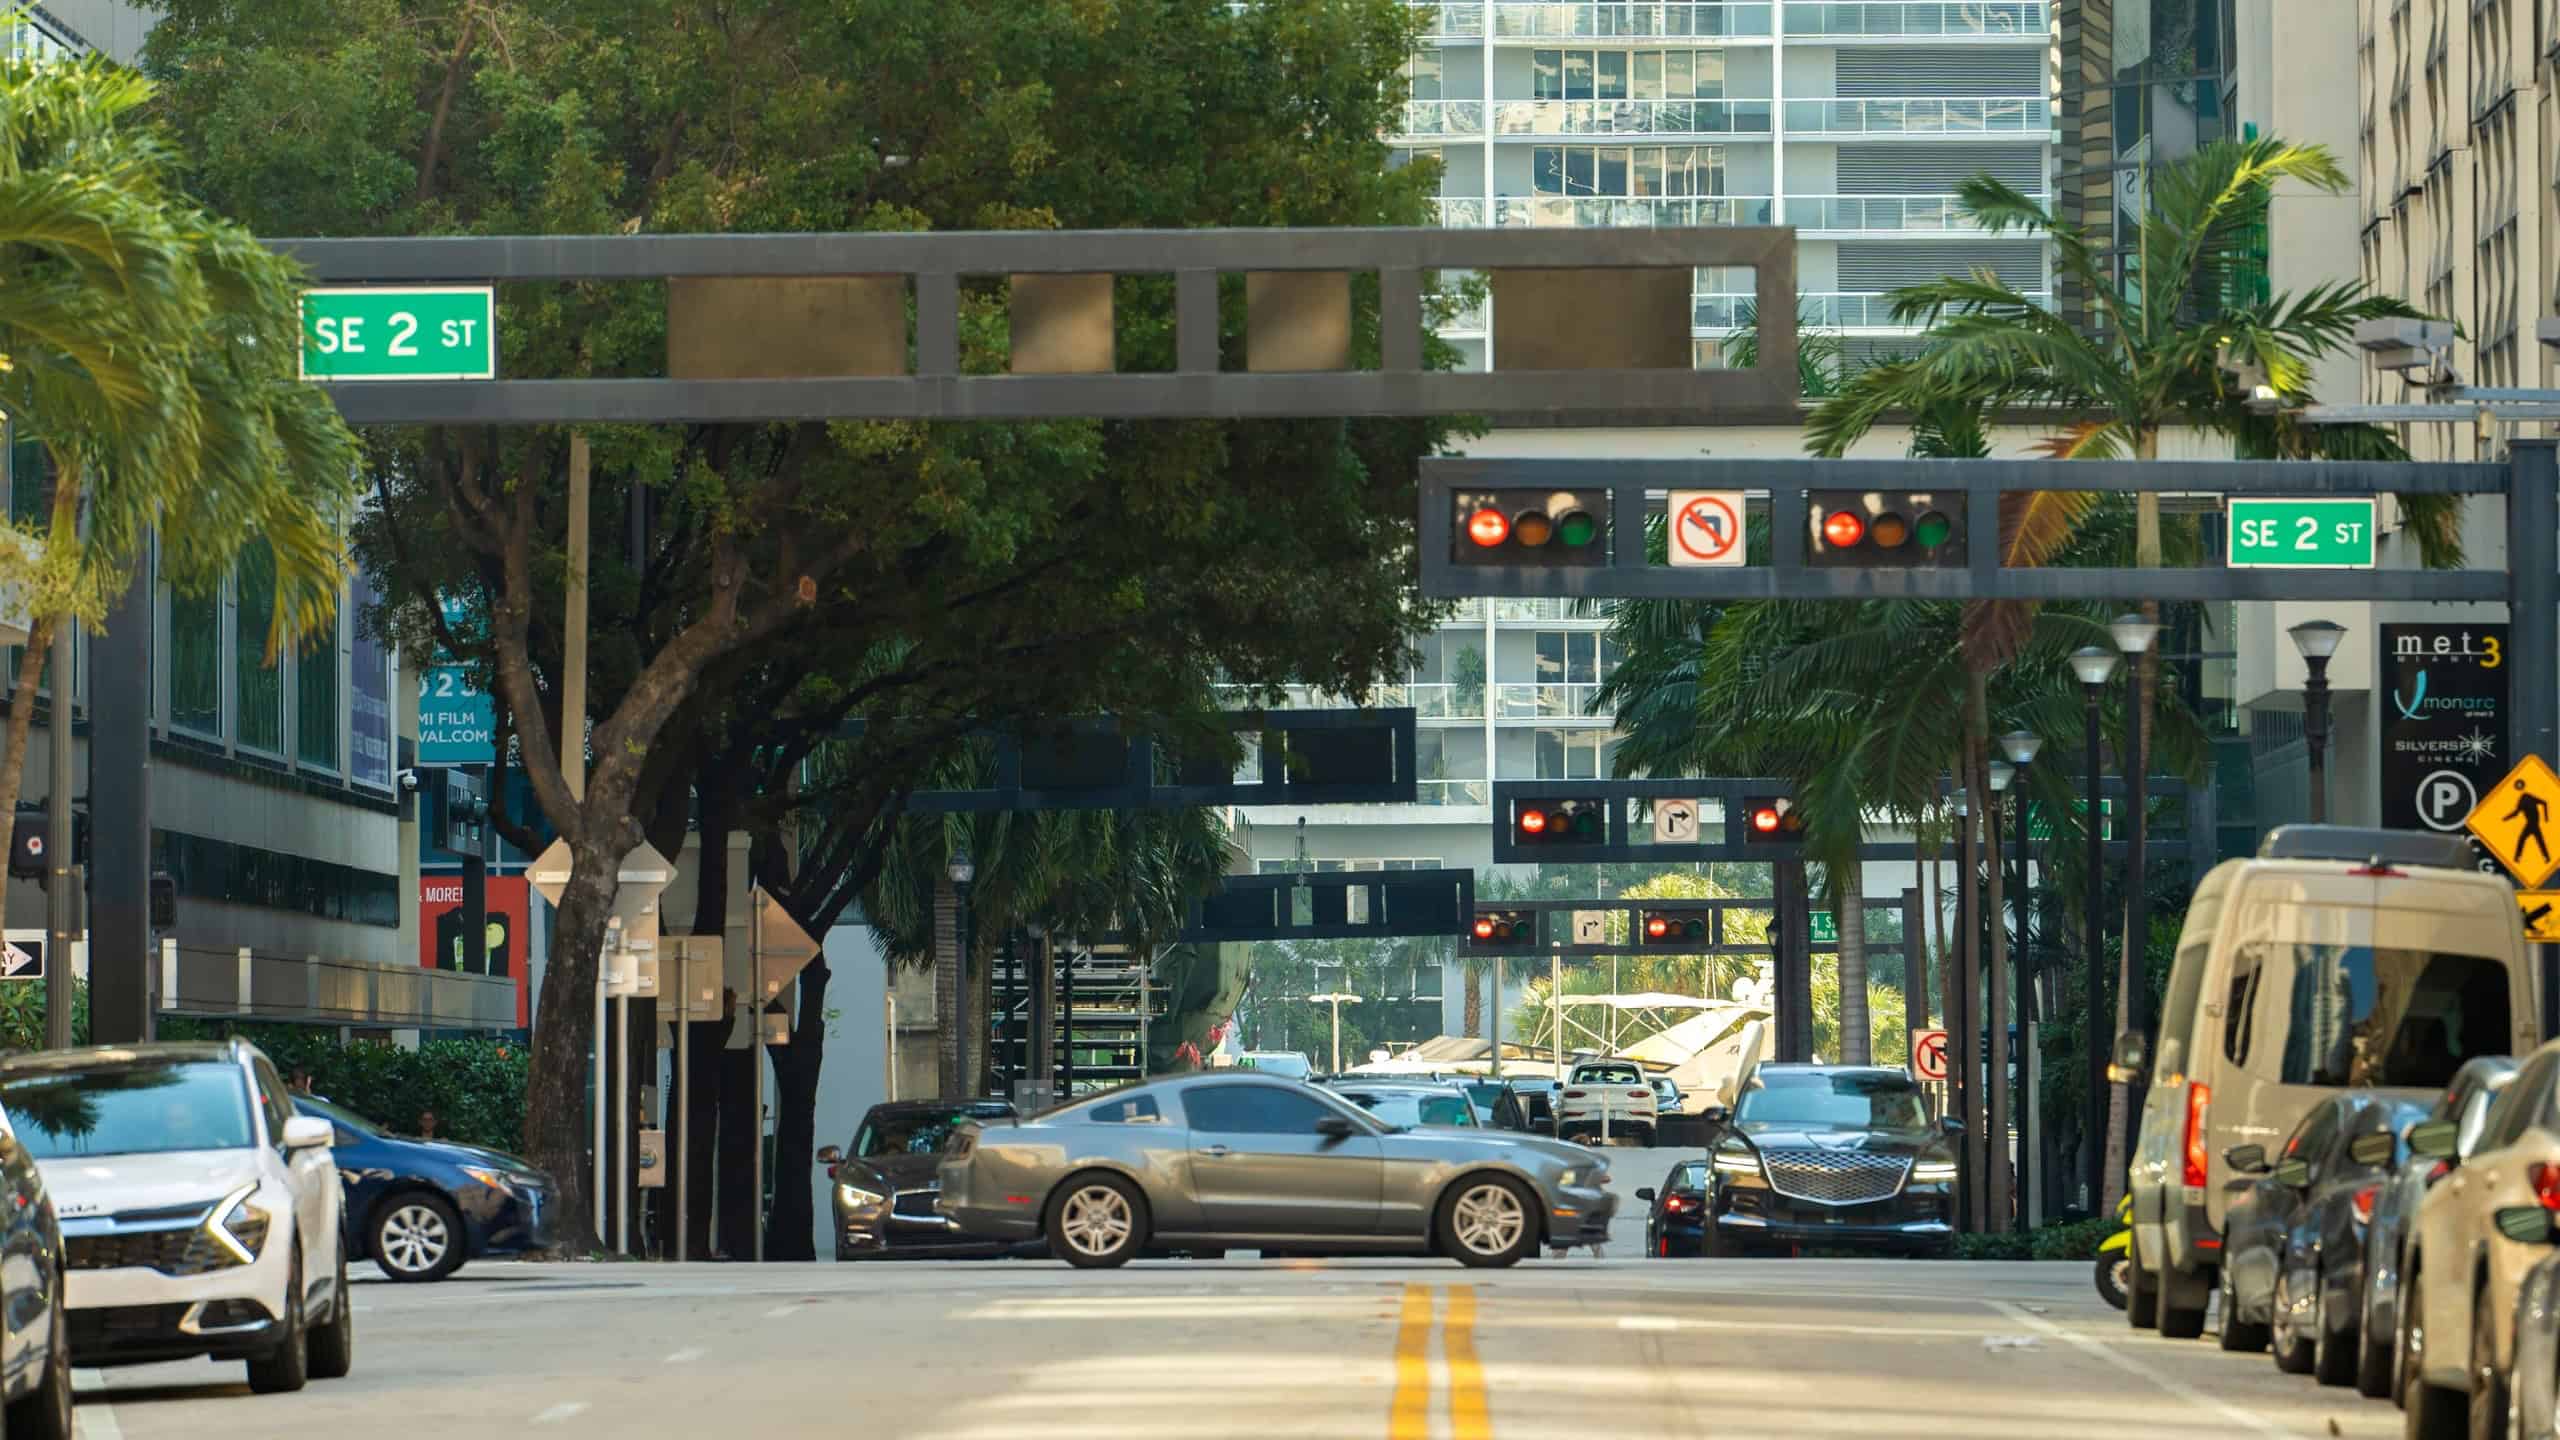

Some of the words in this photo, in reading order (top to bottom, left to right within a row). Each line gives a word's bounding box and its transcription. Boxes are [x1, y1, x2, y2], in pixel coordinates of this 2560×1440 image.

[315, 316, 366, 354] SE
[387, 311, 419, 357] 2
[441, 319, 477, 348] ST
[2239, 519, 2279, 548] SE
[2294, 516, 2319, 550] 2
[2335, 522, 2363, 545] ST
[2423, 697, 2496, 710] monarc
[438, 711, 475, 725] FILM
[2433, 782, 2460, 819] P
[425, 887, 464, 903] MORE!
